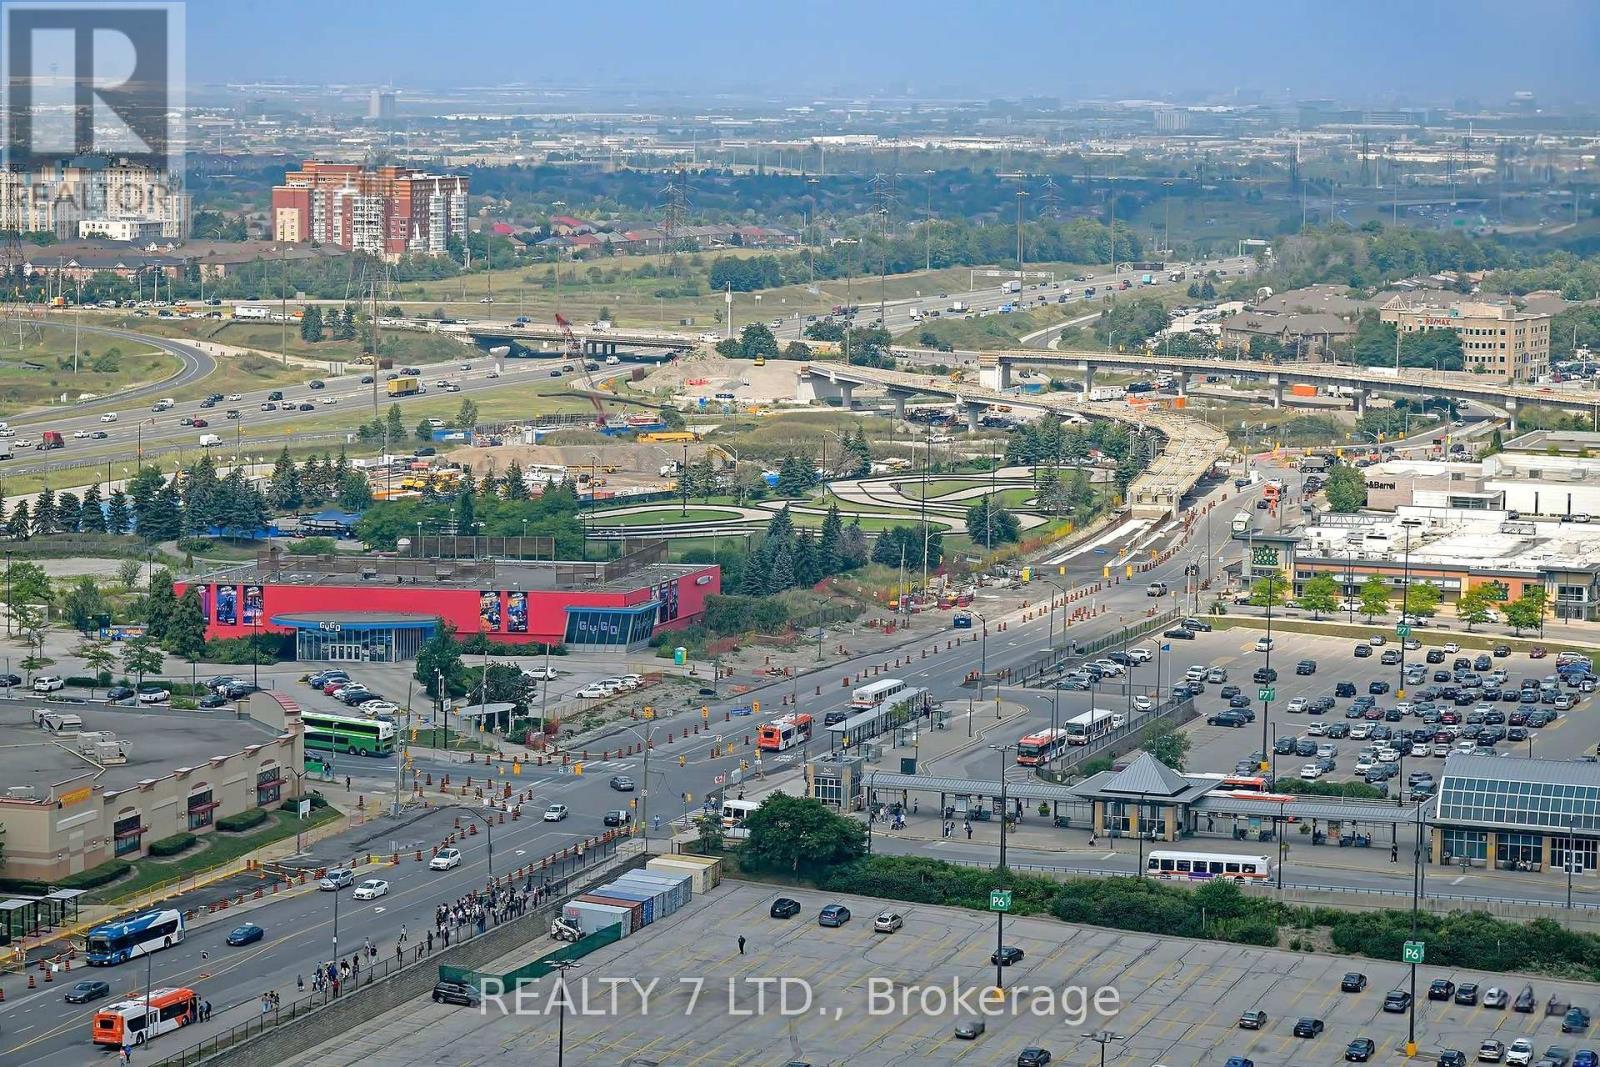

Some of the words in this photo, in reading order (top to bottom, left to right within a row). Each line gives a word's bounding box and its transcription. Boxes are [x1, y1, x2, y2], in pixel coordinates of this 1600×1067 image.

[1259, 690, 1270, 699] P7
[992, 896, 1005, 907] P6
[1405, 948, 1419, 960] P6
